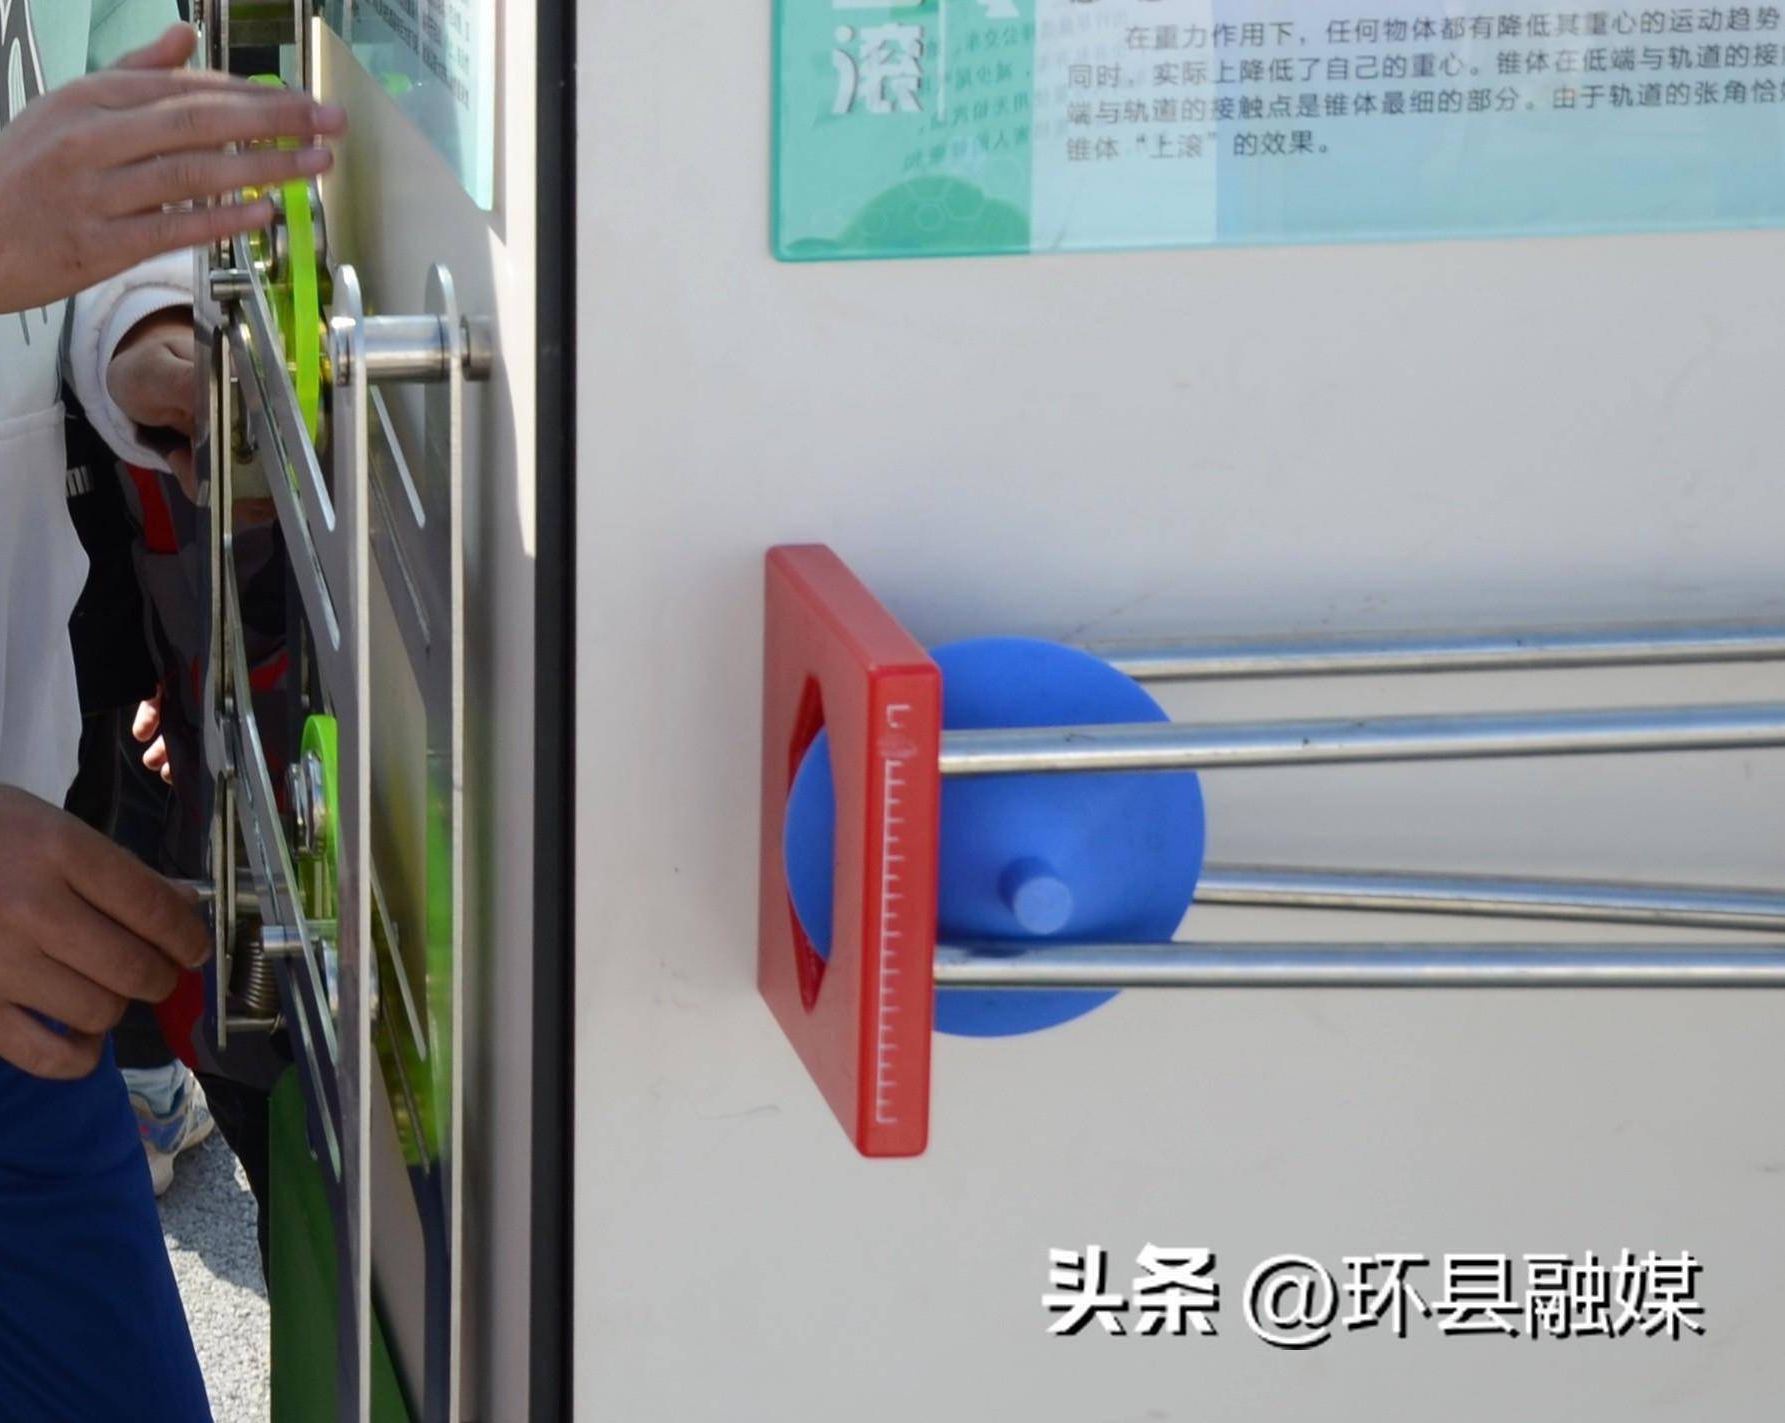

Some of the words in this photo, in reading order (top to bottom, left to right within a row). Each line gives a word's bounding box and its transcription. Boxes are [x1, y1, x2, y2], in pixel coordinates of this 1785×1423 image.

[1067, 42, 1785, 90] 同时，实际上降低了自己的重心。锥体在低端与轨道的接
[1066, 78, 1785, 126] 端与轨道的接触点是锥体最细的部分。由于轨道的张角恰
